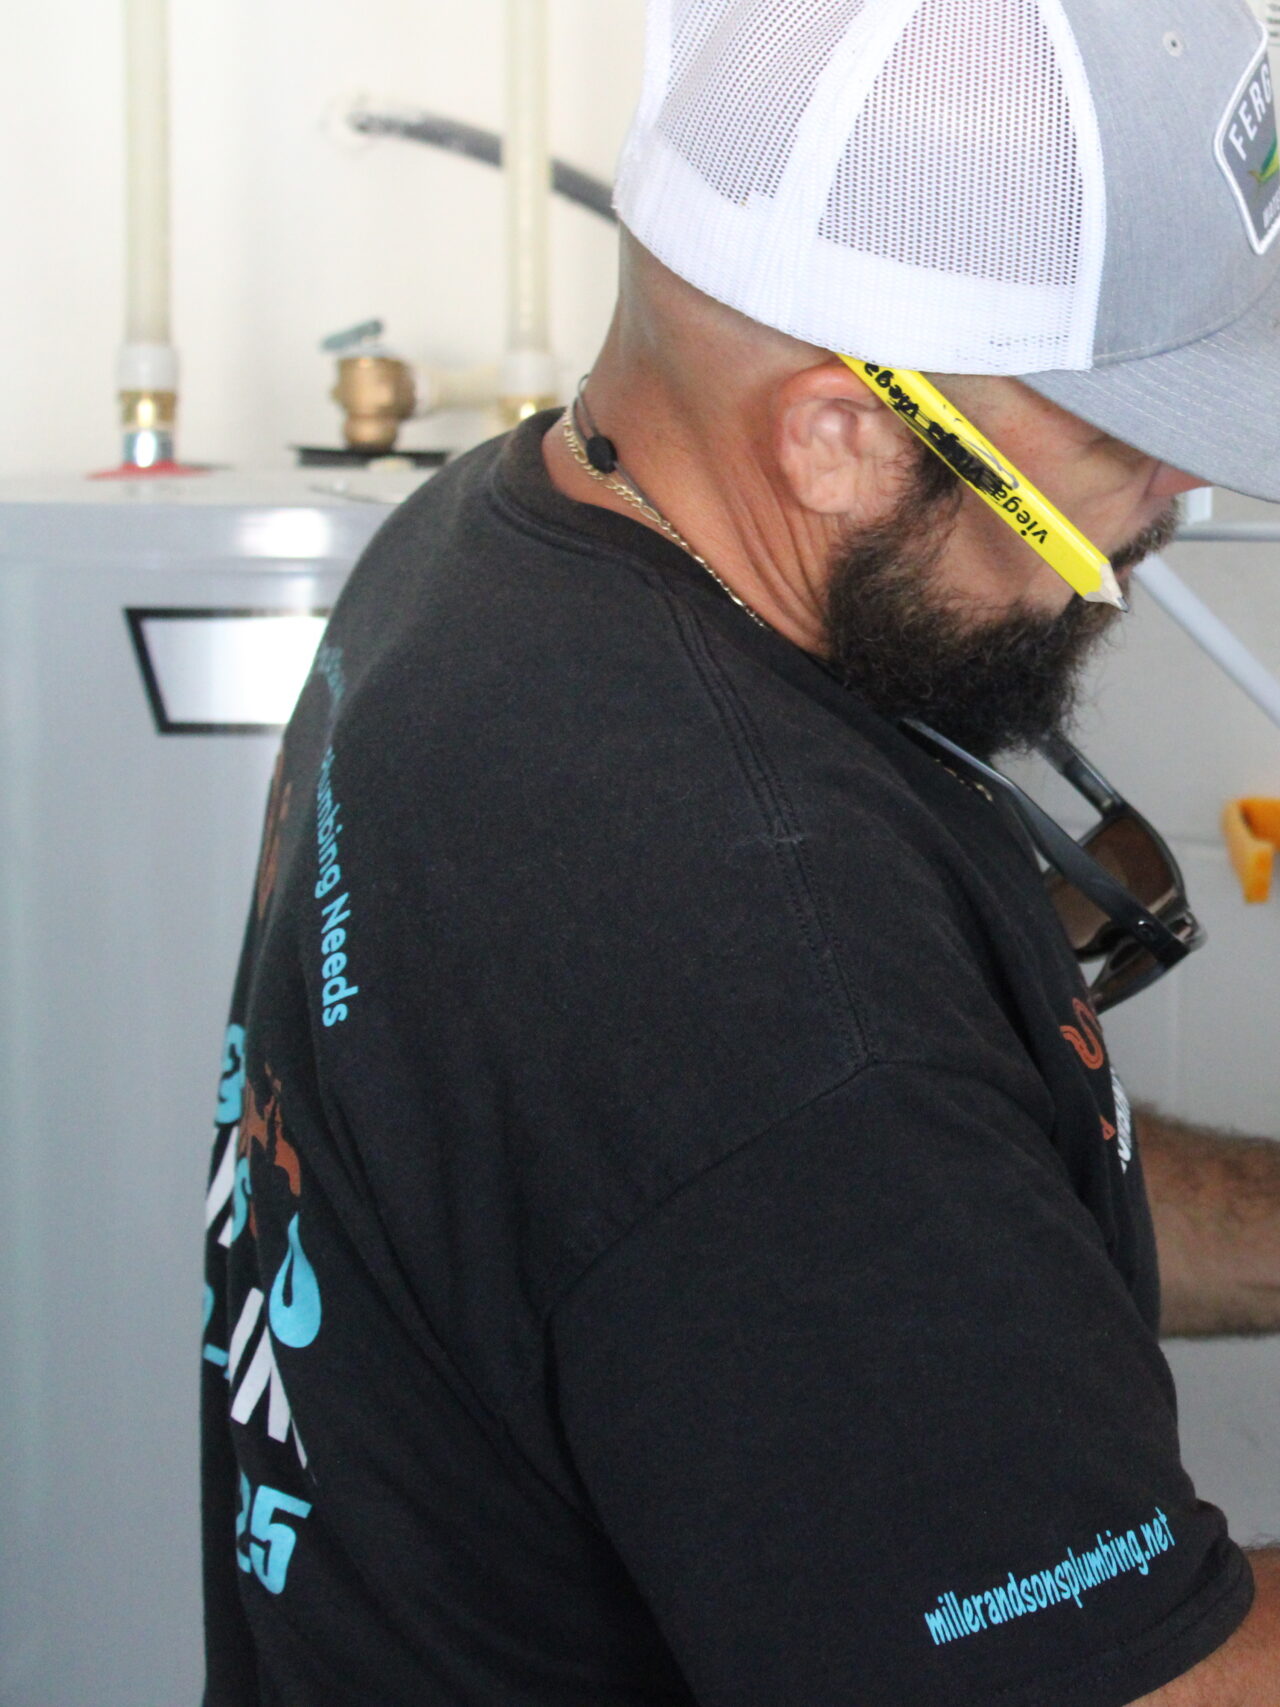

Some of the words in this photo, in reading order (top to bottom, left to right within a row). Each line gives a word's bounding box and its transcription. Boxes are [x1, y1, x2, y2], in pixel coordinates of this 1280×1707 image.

[991, 481, 1049, 544] viega
[320, 893, 359, 1028] Needs
[924, 1506, 1176, 1645] millerandsonsplumbing.net
